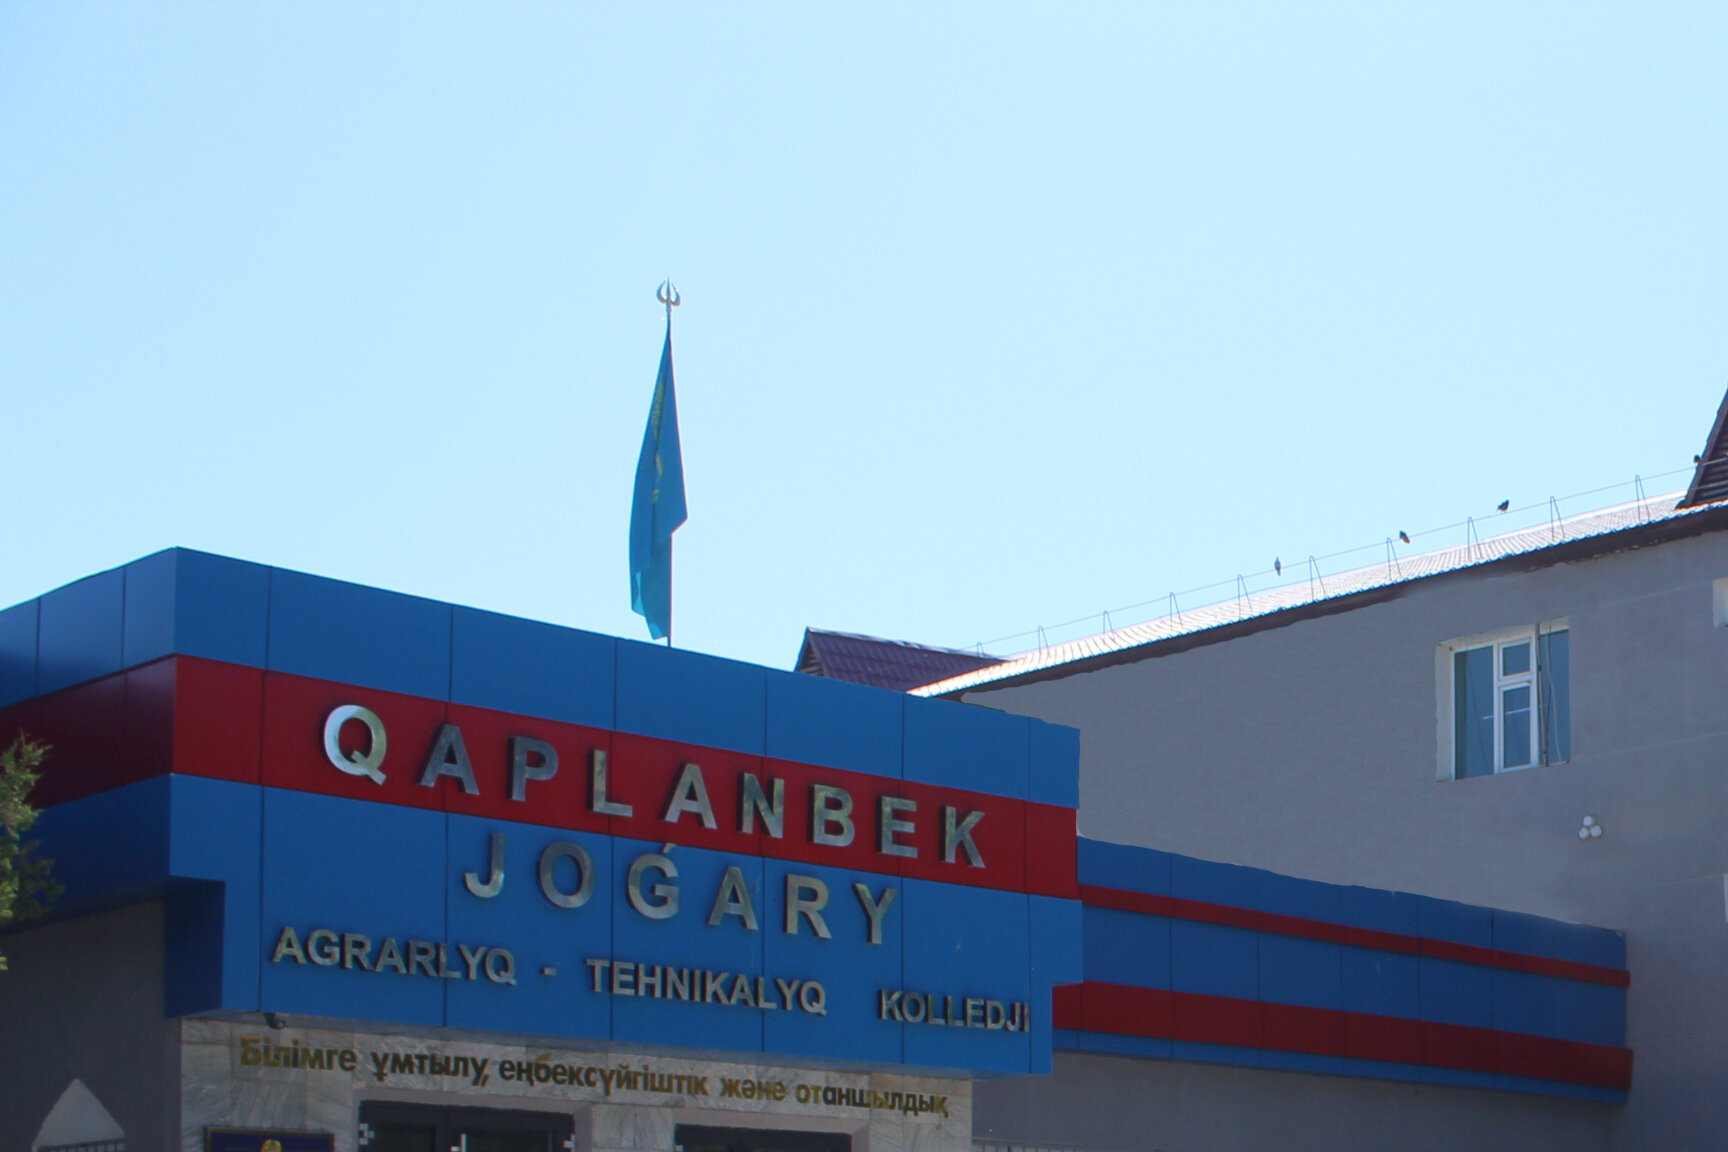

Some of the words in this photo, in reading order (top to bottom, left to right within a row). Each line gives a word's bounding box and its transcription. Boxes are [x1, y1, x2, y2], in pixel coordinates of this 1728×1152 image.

[323, 704, 987, 870] QAPLANBEK
[271, 926, 517, 986] AGRARLYQ
[584, 957, 827, 1016] TEHNIKALYQ
[877, 989, 1031, 1033] KOLLEDJI
[239, 1034, 358, 1072] Білімге
[370, 1050, 491, 1087] ұмтылу,
[719, 1076, 787, 1102] және
[795, 1083, 950, 1118] отаншылдық
